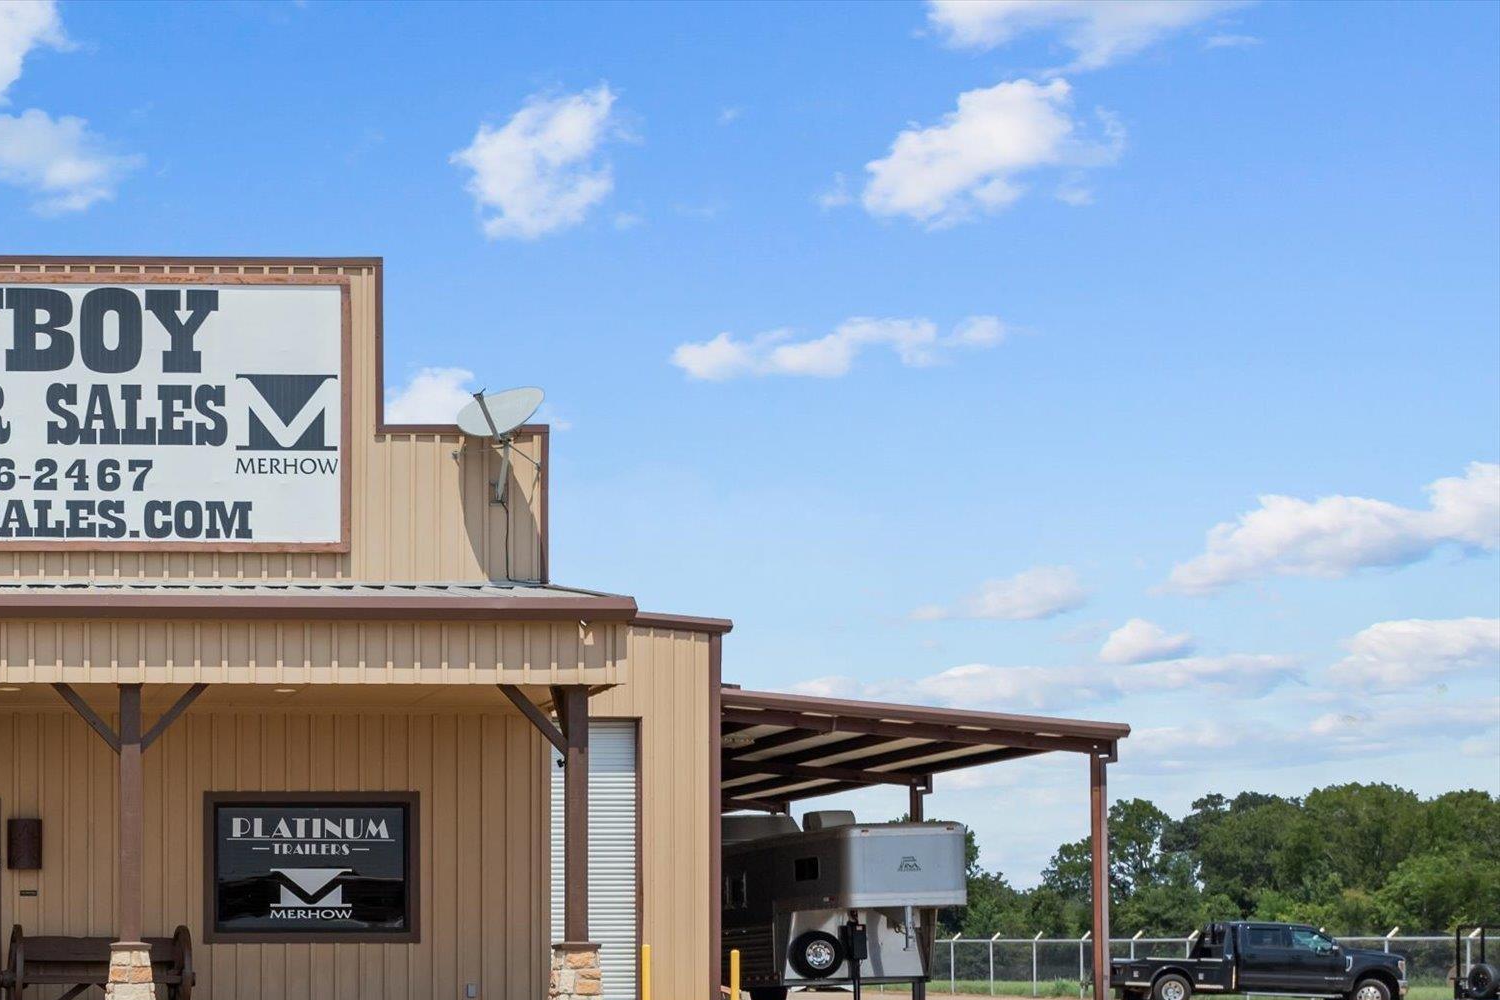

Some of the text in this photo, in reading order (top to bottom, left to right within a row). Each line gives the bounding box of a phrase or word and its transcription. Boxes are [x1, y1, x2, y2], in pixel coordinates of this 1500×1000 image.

[45, 382, 228, 447] SALES
[235, 457, 339, 475] MERHOW
[232, 817, 390, 839] PLATINUM
[272, 843, 350, 855] TRAILERS
[269, 909, 352, 919] MERHOW
